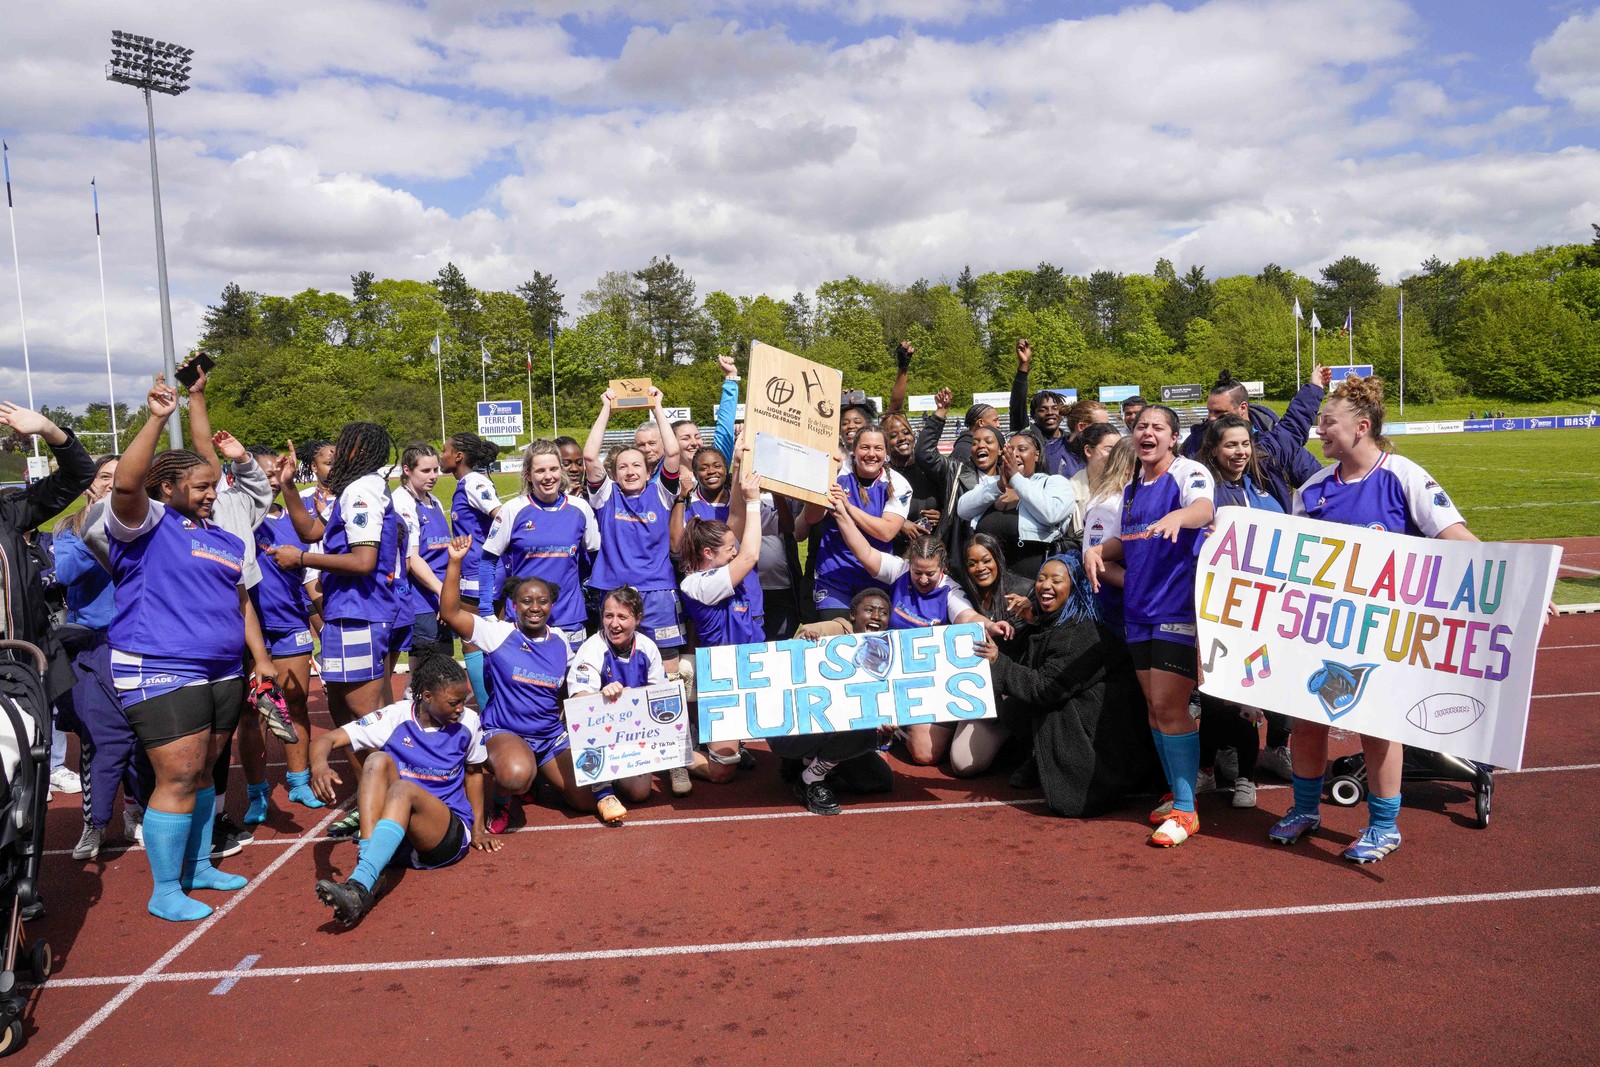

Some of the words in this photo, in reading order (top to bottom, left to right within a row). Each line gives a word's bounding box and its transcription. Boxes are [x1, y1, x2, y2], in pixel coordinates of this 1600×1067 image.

[754, 408, 801, 427] HAUTS-DE-FRANCE
[767, 406, 782, 415] LIGUE
[783, 411, 801, 421] RUGBY
[788, 407, 802, 415] FFR
[484, 416, 507, 424] TERRE
[1564, 417, 1596, 426] MASSY
[480, 425, 522, 434] CHAMPIONS
[807, 424, 833, 437] Rugby
[1209, 521, 1346, 590] ALLEZ
[1343, 542, 1506, 615] LAULAU
[1199, 572, 1307, 640] LET'S
[1300, 593, 1357, 650] GO
[1357, 603, 1514, 682] FURIES
[695, 634, 858, 693] LET'S
[898, 622, 987, 675] GO
[145, 676, 172, 684] STADE
[697, 672, 987, 744] FURIES
[587, 713, 615, 728] Let's
[618, 710, 633, 722] go
[614, 727, 660, 744] Furies
